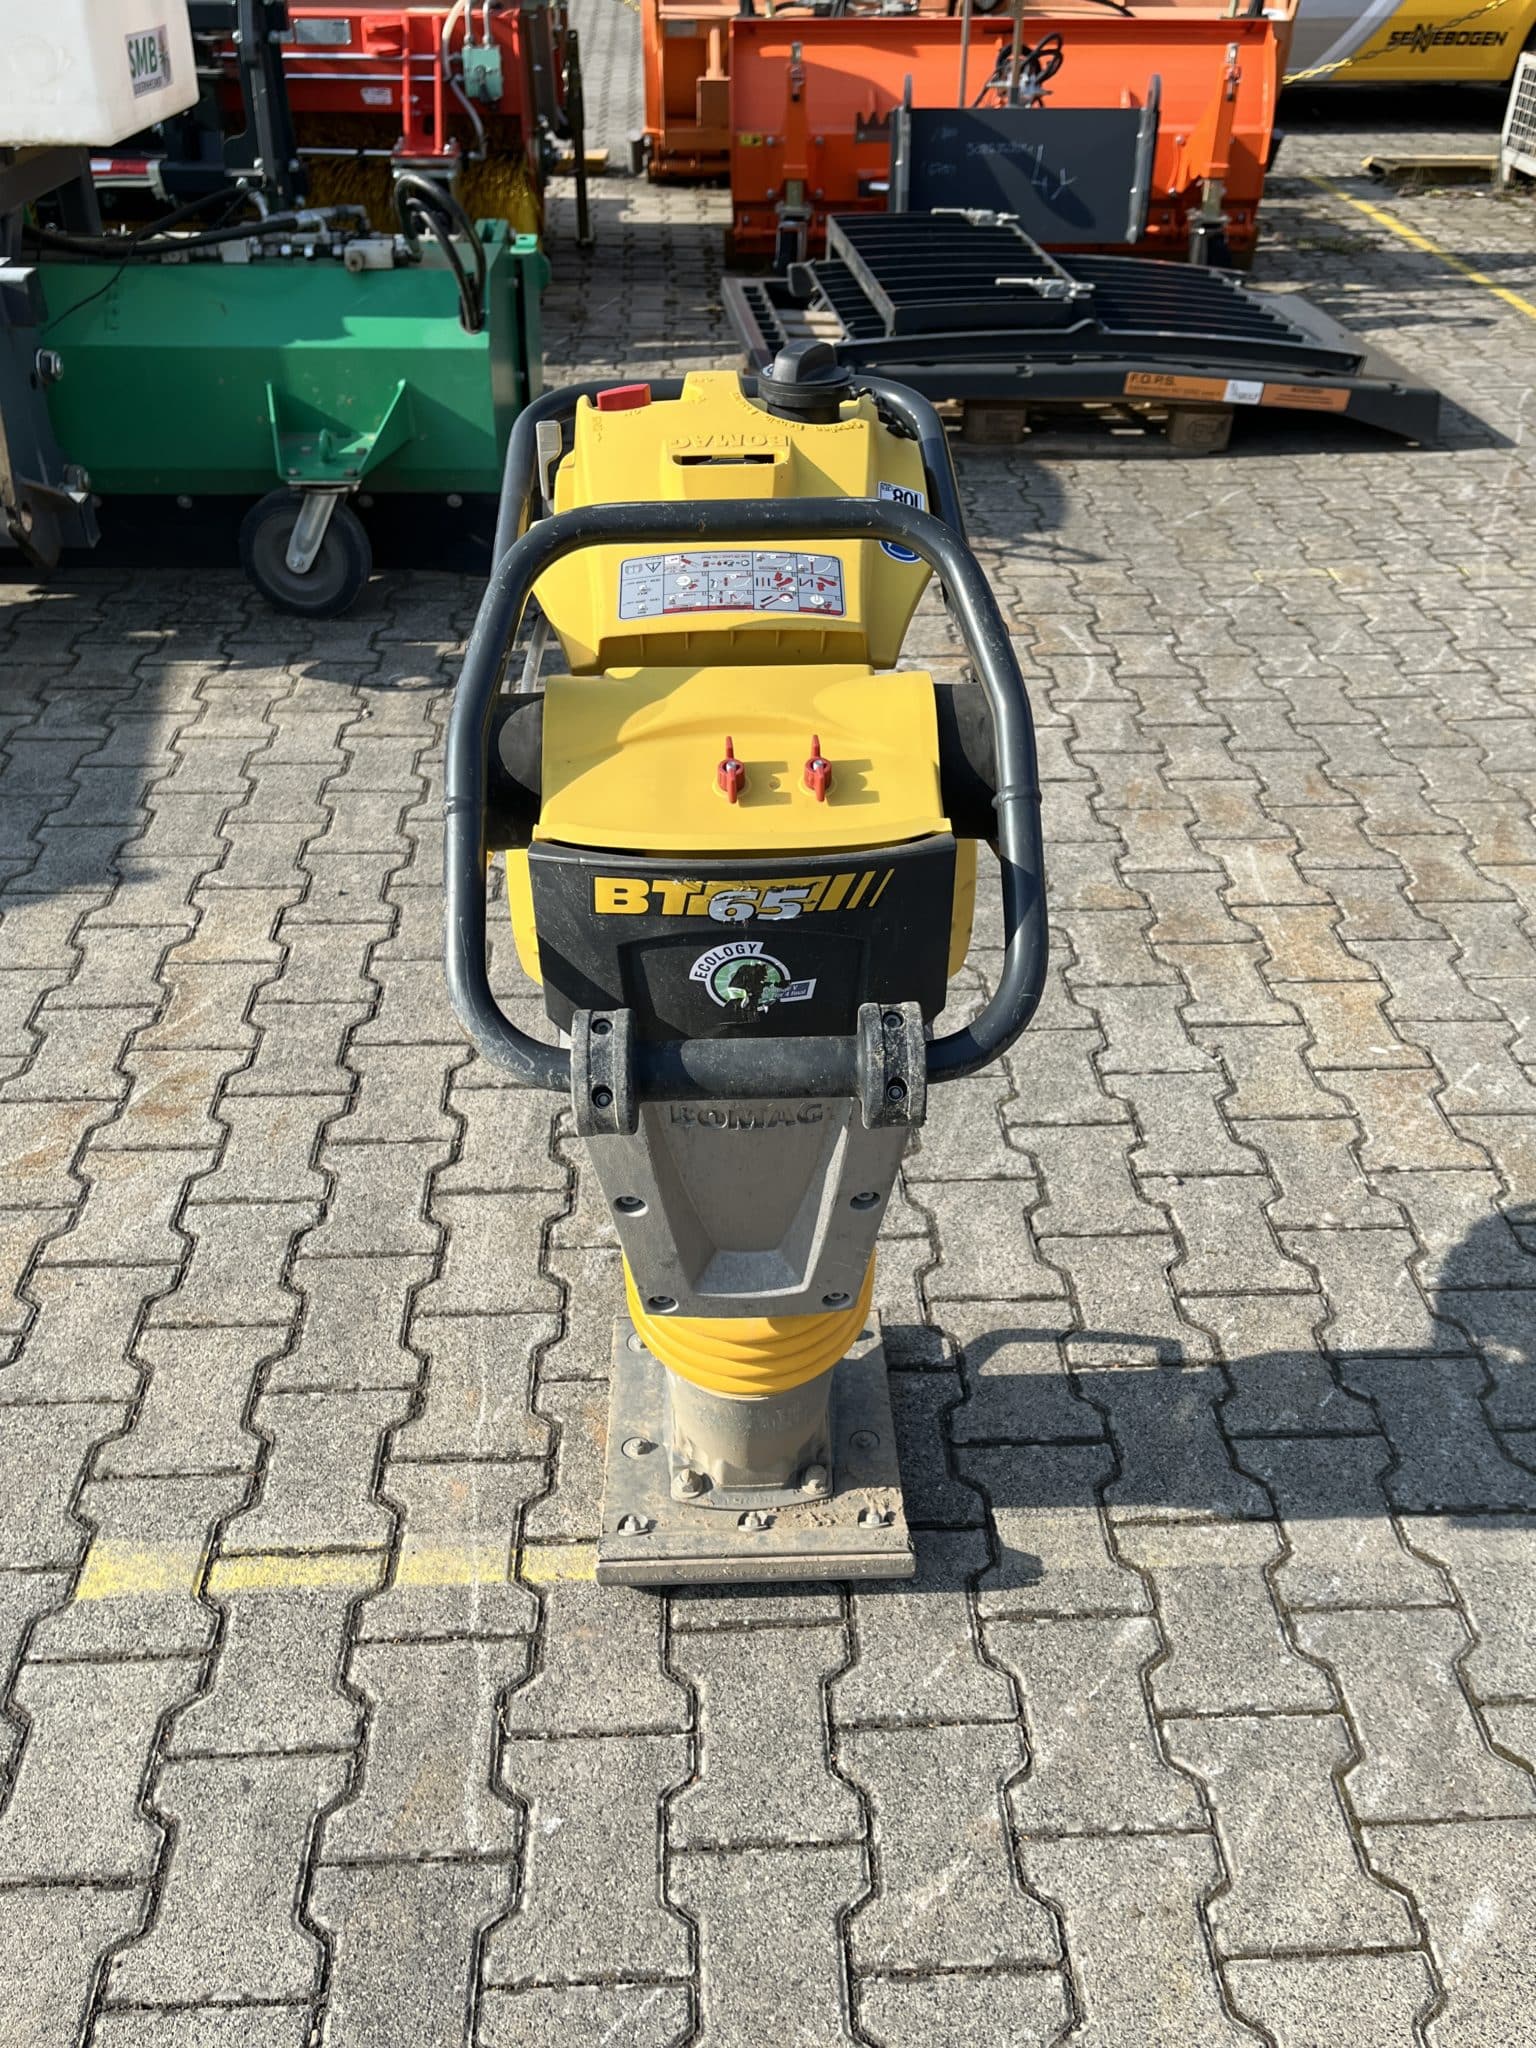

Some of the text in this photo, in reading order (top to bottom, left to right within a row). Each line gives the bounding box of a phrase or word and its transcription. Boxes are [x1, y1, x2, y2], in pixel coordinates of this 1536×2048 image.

[1387, 23, 1509, 54] SENNEBOGEN
[127, 36, 158, 79] SMB
[671, 433, 791, 448] BOMAG
[708, 888, 812, 922] 65
[694, 943, 757, 979] ECOLOGY
[670, 1103, 823, 1130] BOMAG
